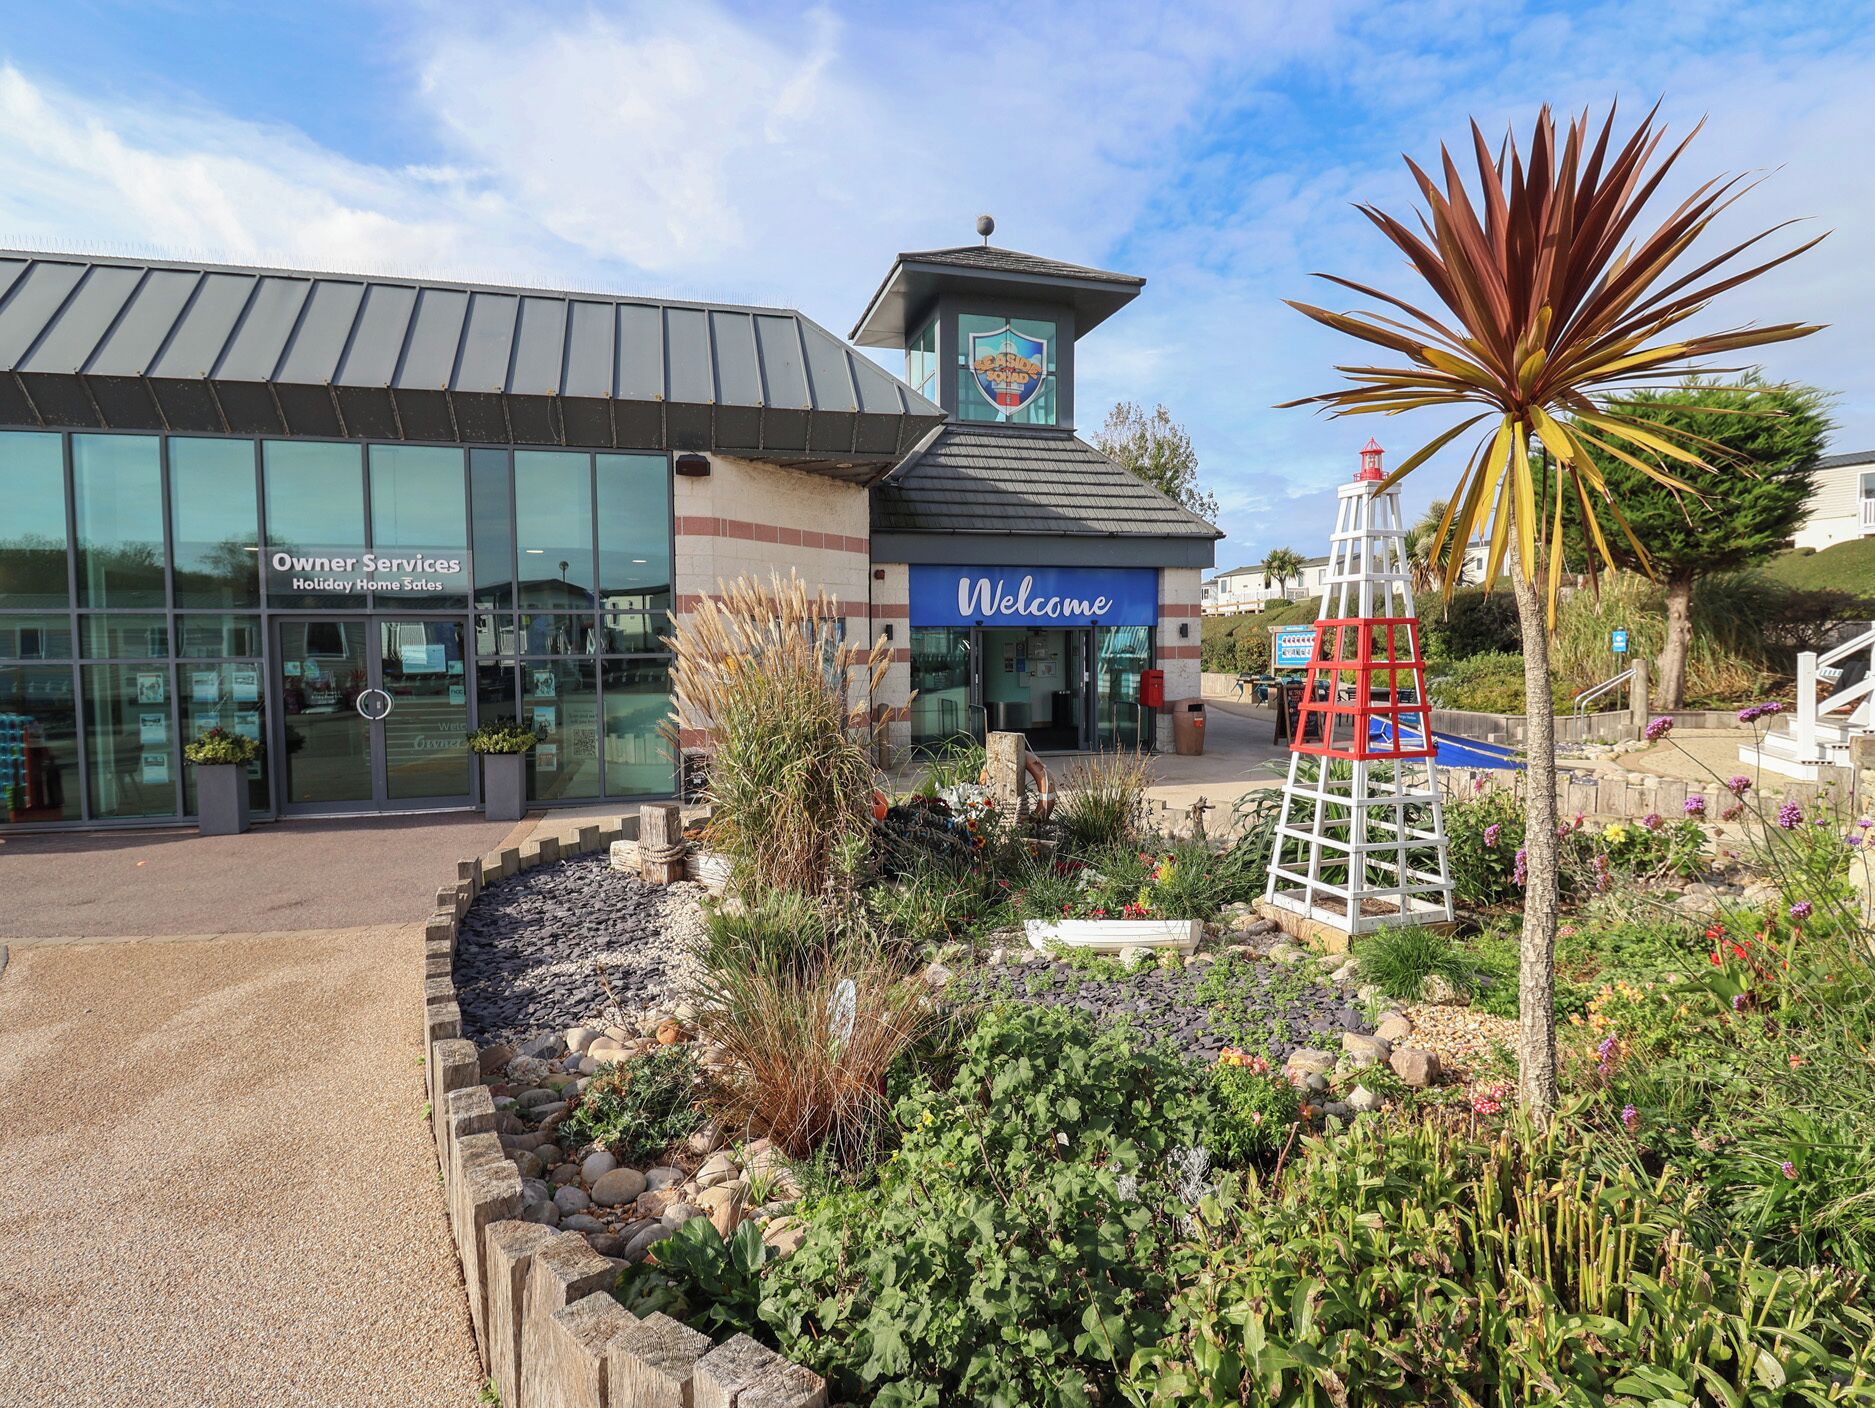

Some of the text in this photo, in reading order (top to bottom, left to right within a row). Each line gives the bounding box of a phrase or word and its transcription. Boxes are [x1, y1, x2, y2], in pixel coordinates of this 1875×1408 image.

[974, 353, 1042, 379] SEASIDE
[986, 371, 1029, 384] SQUAD
[272, 552, 461, 573] Owner Services
[292, 577, 443, 594] Holiday Home Sales
[958, 575, 1113, 618] Welcome
[438, 721, 467, 731] Welc
